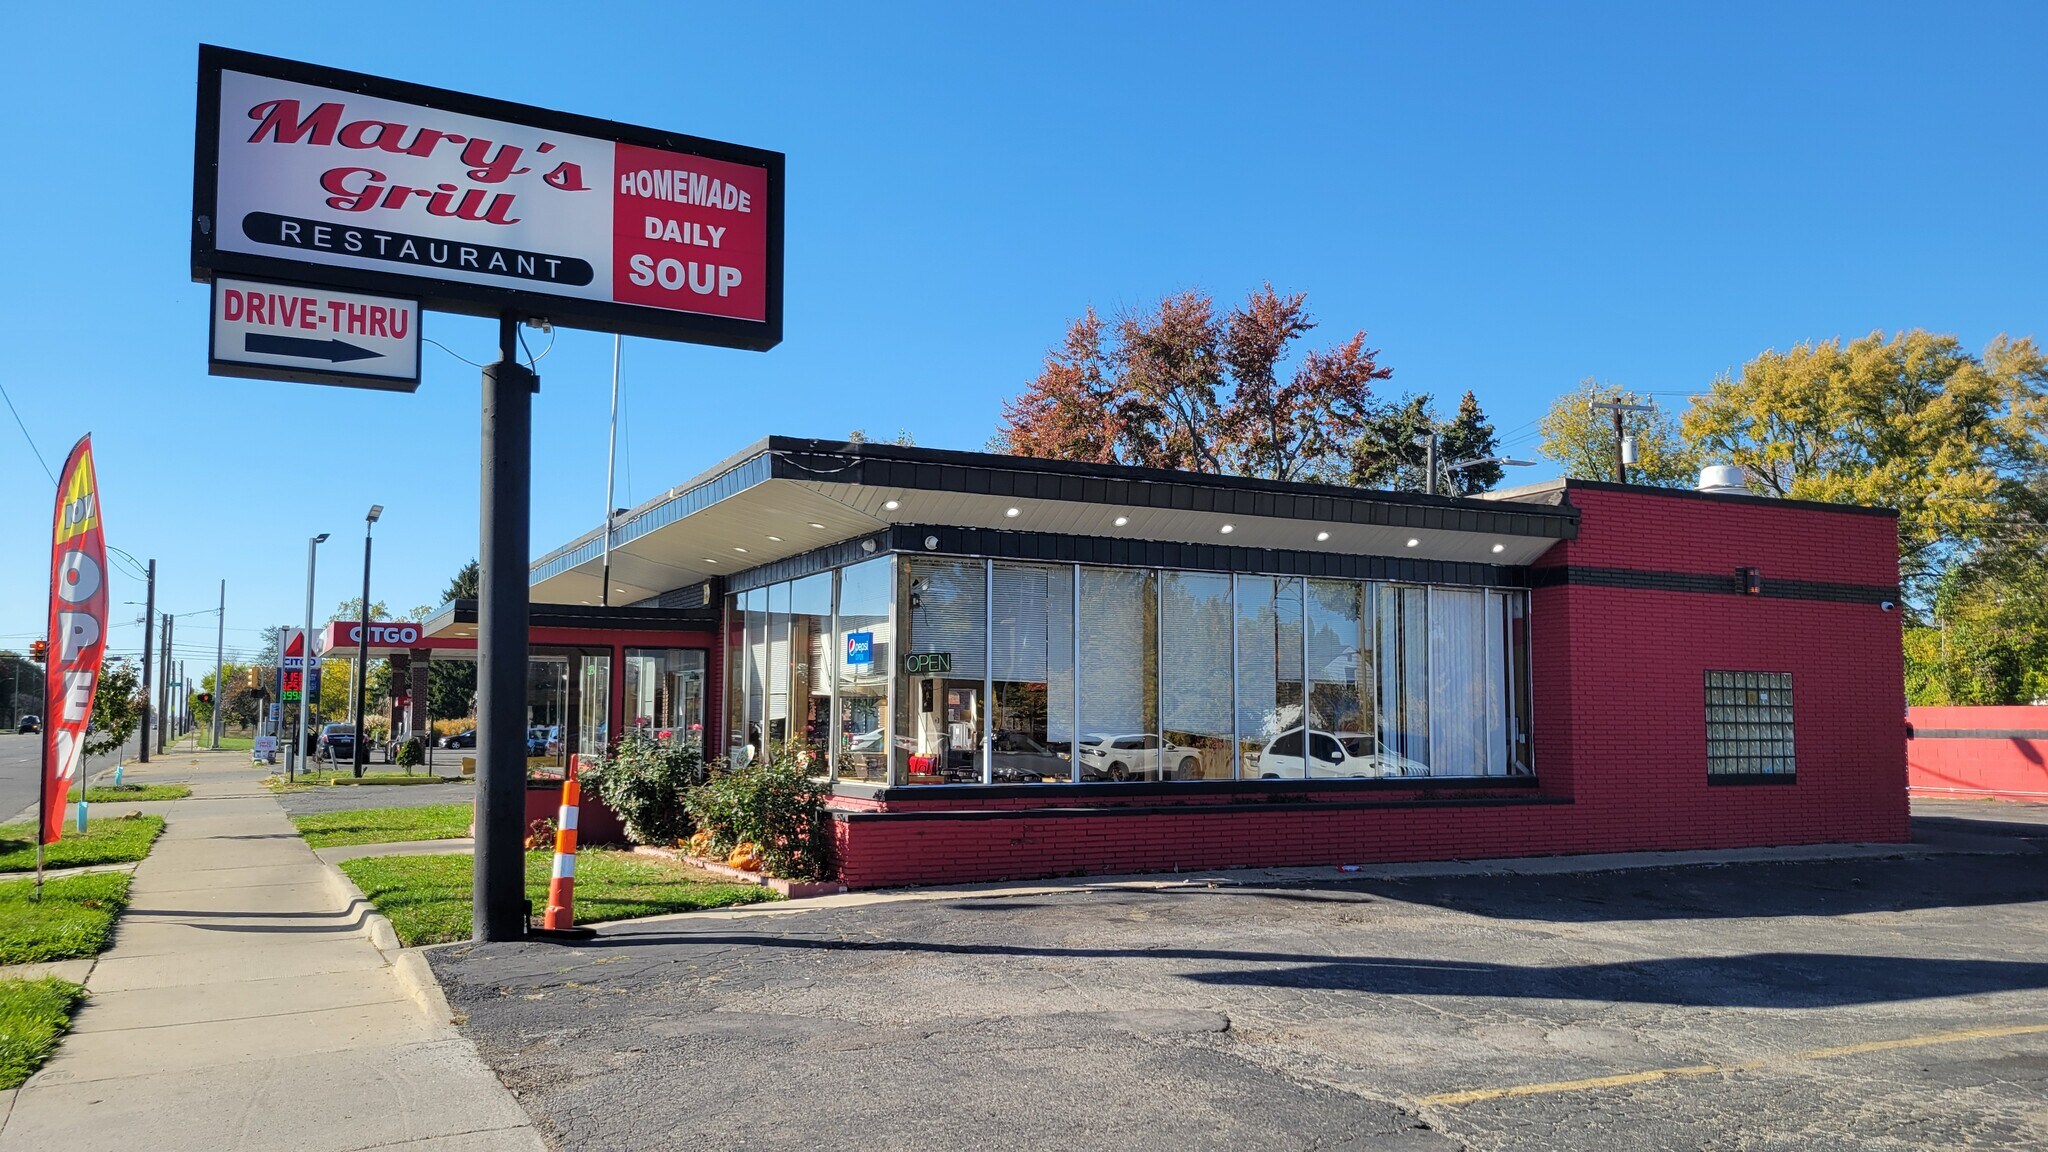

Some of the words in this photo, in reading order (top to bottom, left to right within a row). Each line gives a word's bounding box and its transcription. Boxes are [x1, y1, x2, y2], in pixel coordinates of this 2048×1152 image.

[247, 99, 592, 192] Mary's
[319, 167, 522, 225] Grill
[620, 169, 751, 213] HOMEMADE
[280, 220, 562, 279] RESTAURANT
[644, 216, 727, 248] DAILY
[629, 253, 743, 297] SOUP
[224, 289, 409, 340] DRIVE-THRU
[855, 640, 869, 653] pepsi
[906, 653, 950, 672] OPEN
